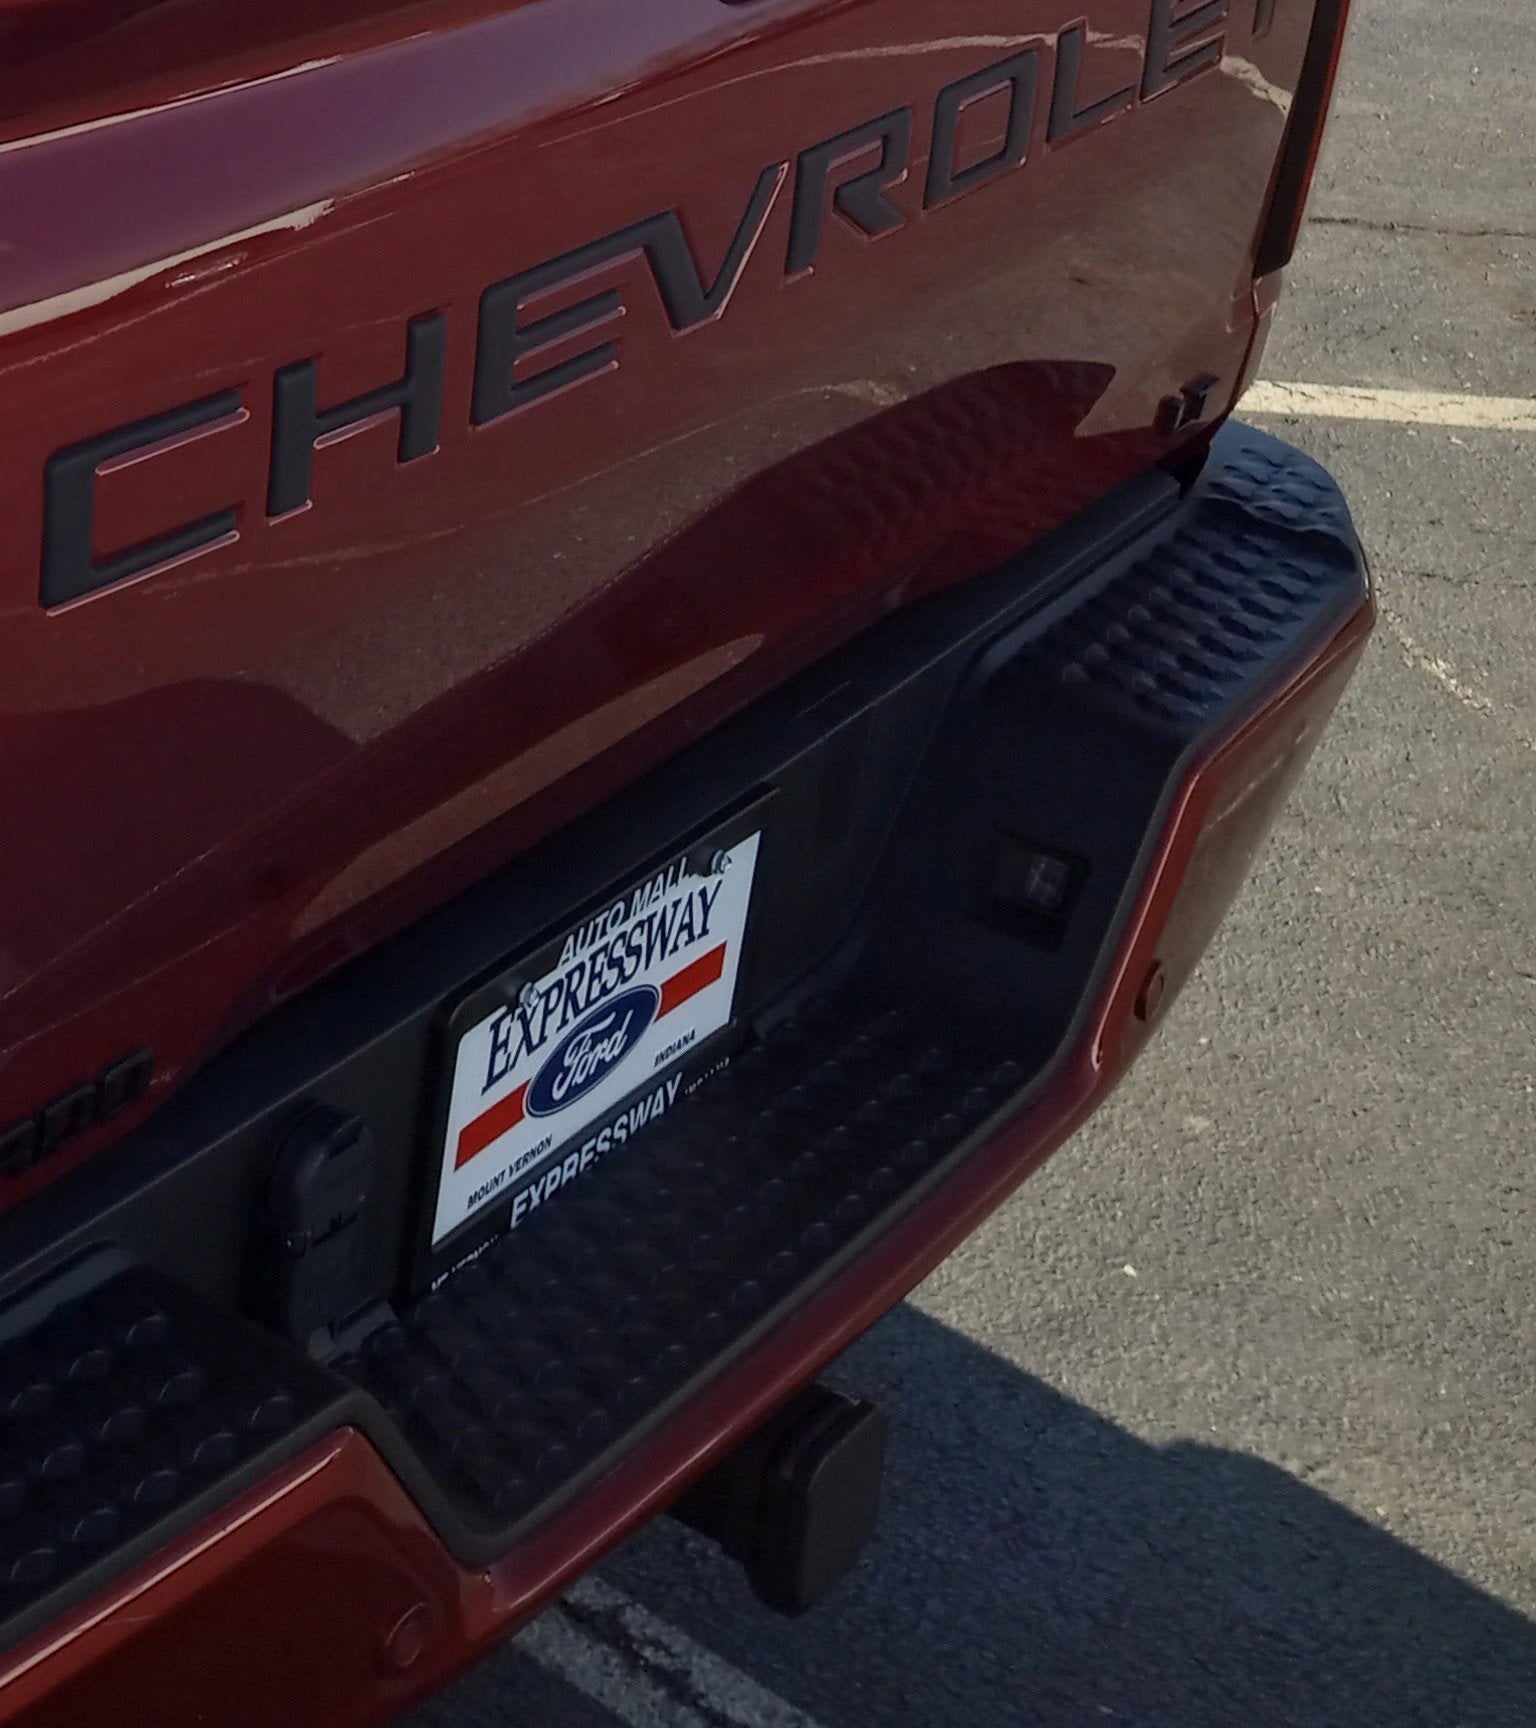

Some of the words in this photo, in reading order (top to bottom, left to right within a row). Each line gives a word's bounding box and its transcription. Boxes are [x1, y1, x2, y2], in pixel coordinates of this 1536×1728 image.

[556, 900, 626, 970] AUTO
[631, 856, 693, 914] MALL
[481, 878, 723, 1096] EXPRESSWAY
[551, 1009, 634, 1101] Ford
[654, 1028, 697, 1068] INDIANA
[467, 1170, 506, 1210] MOUNT
[508, 1133, 553, 1179] VERNON
[509, 1072, 682, 1230] EXPRESSWAY
